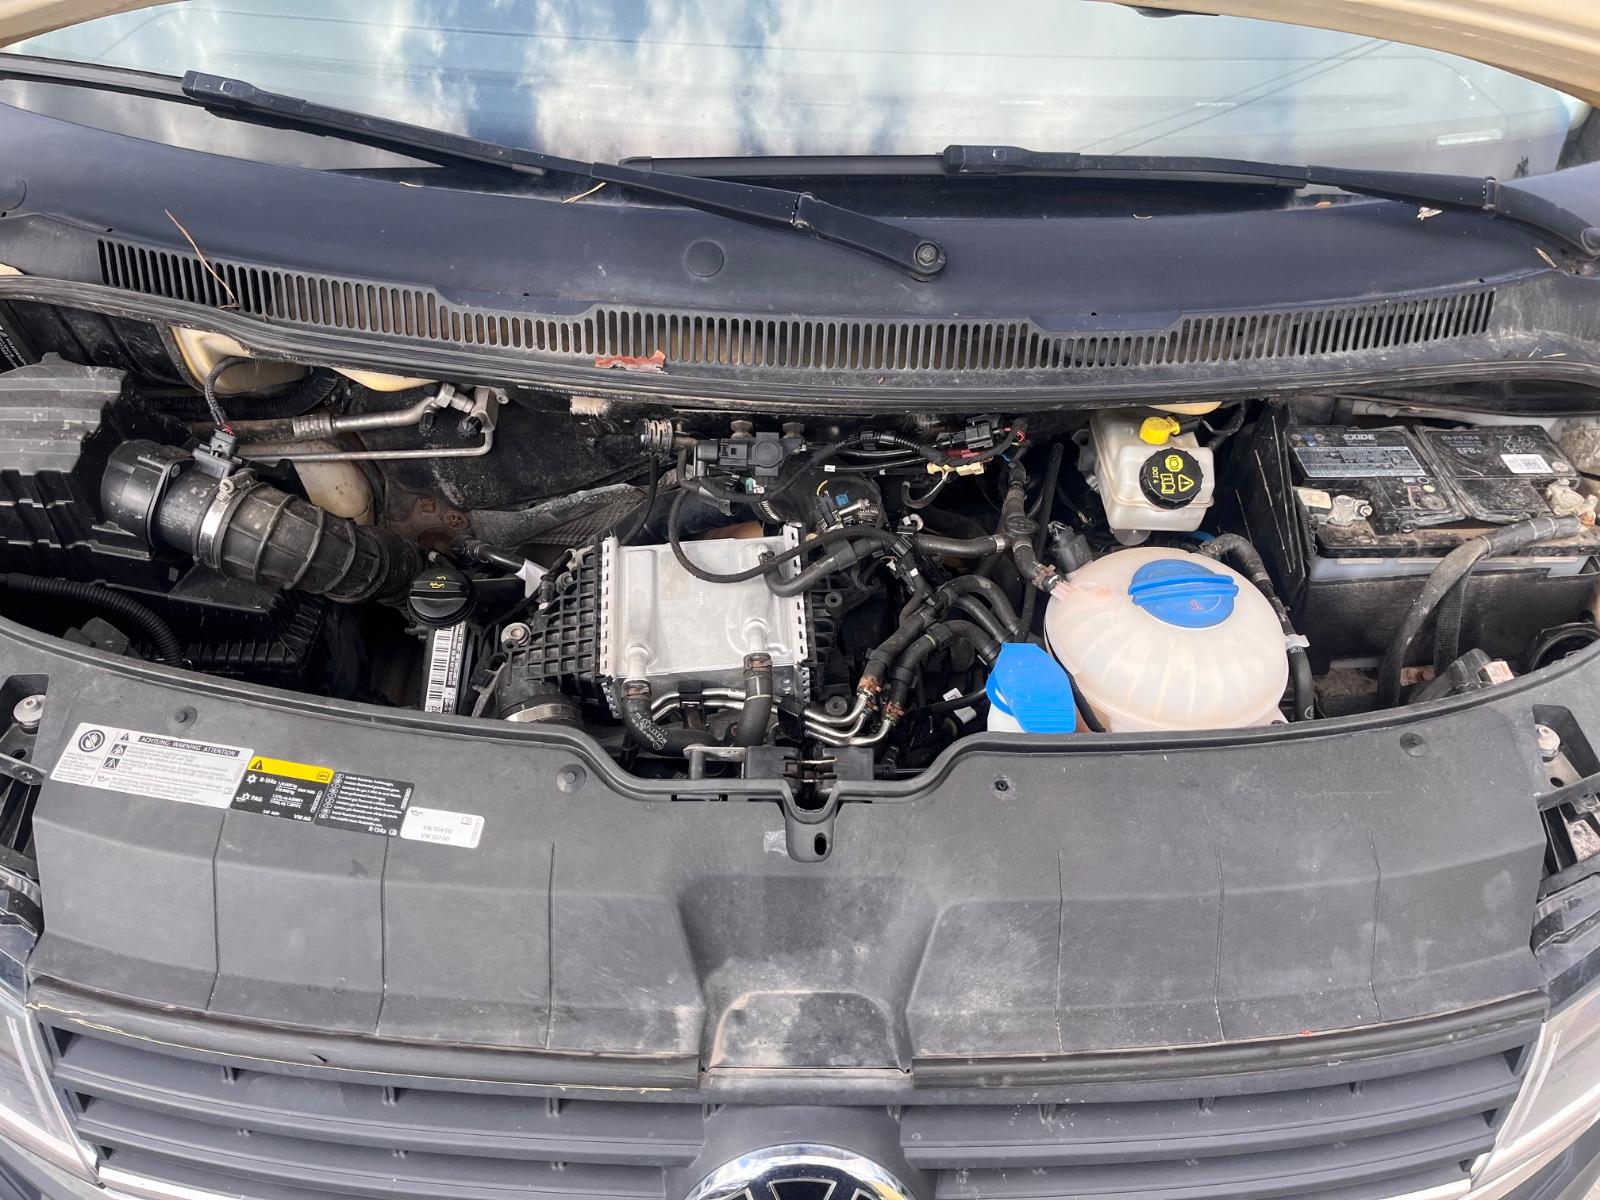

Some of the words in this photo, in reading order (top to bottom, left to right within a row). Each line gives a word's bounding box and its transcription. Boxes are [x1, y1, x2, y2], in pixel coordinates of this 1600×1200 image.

[140, 736, 170, 747] ACHTUNG
[172, 741, 201, 751] WARNING
[203, 747, 236, 757] ATTENTION
